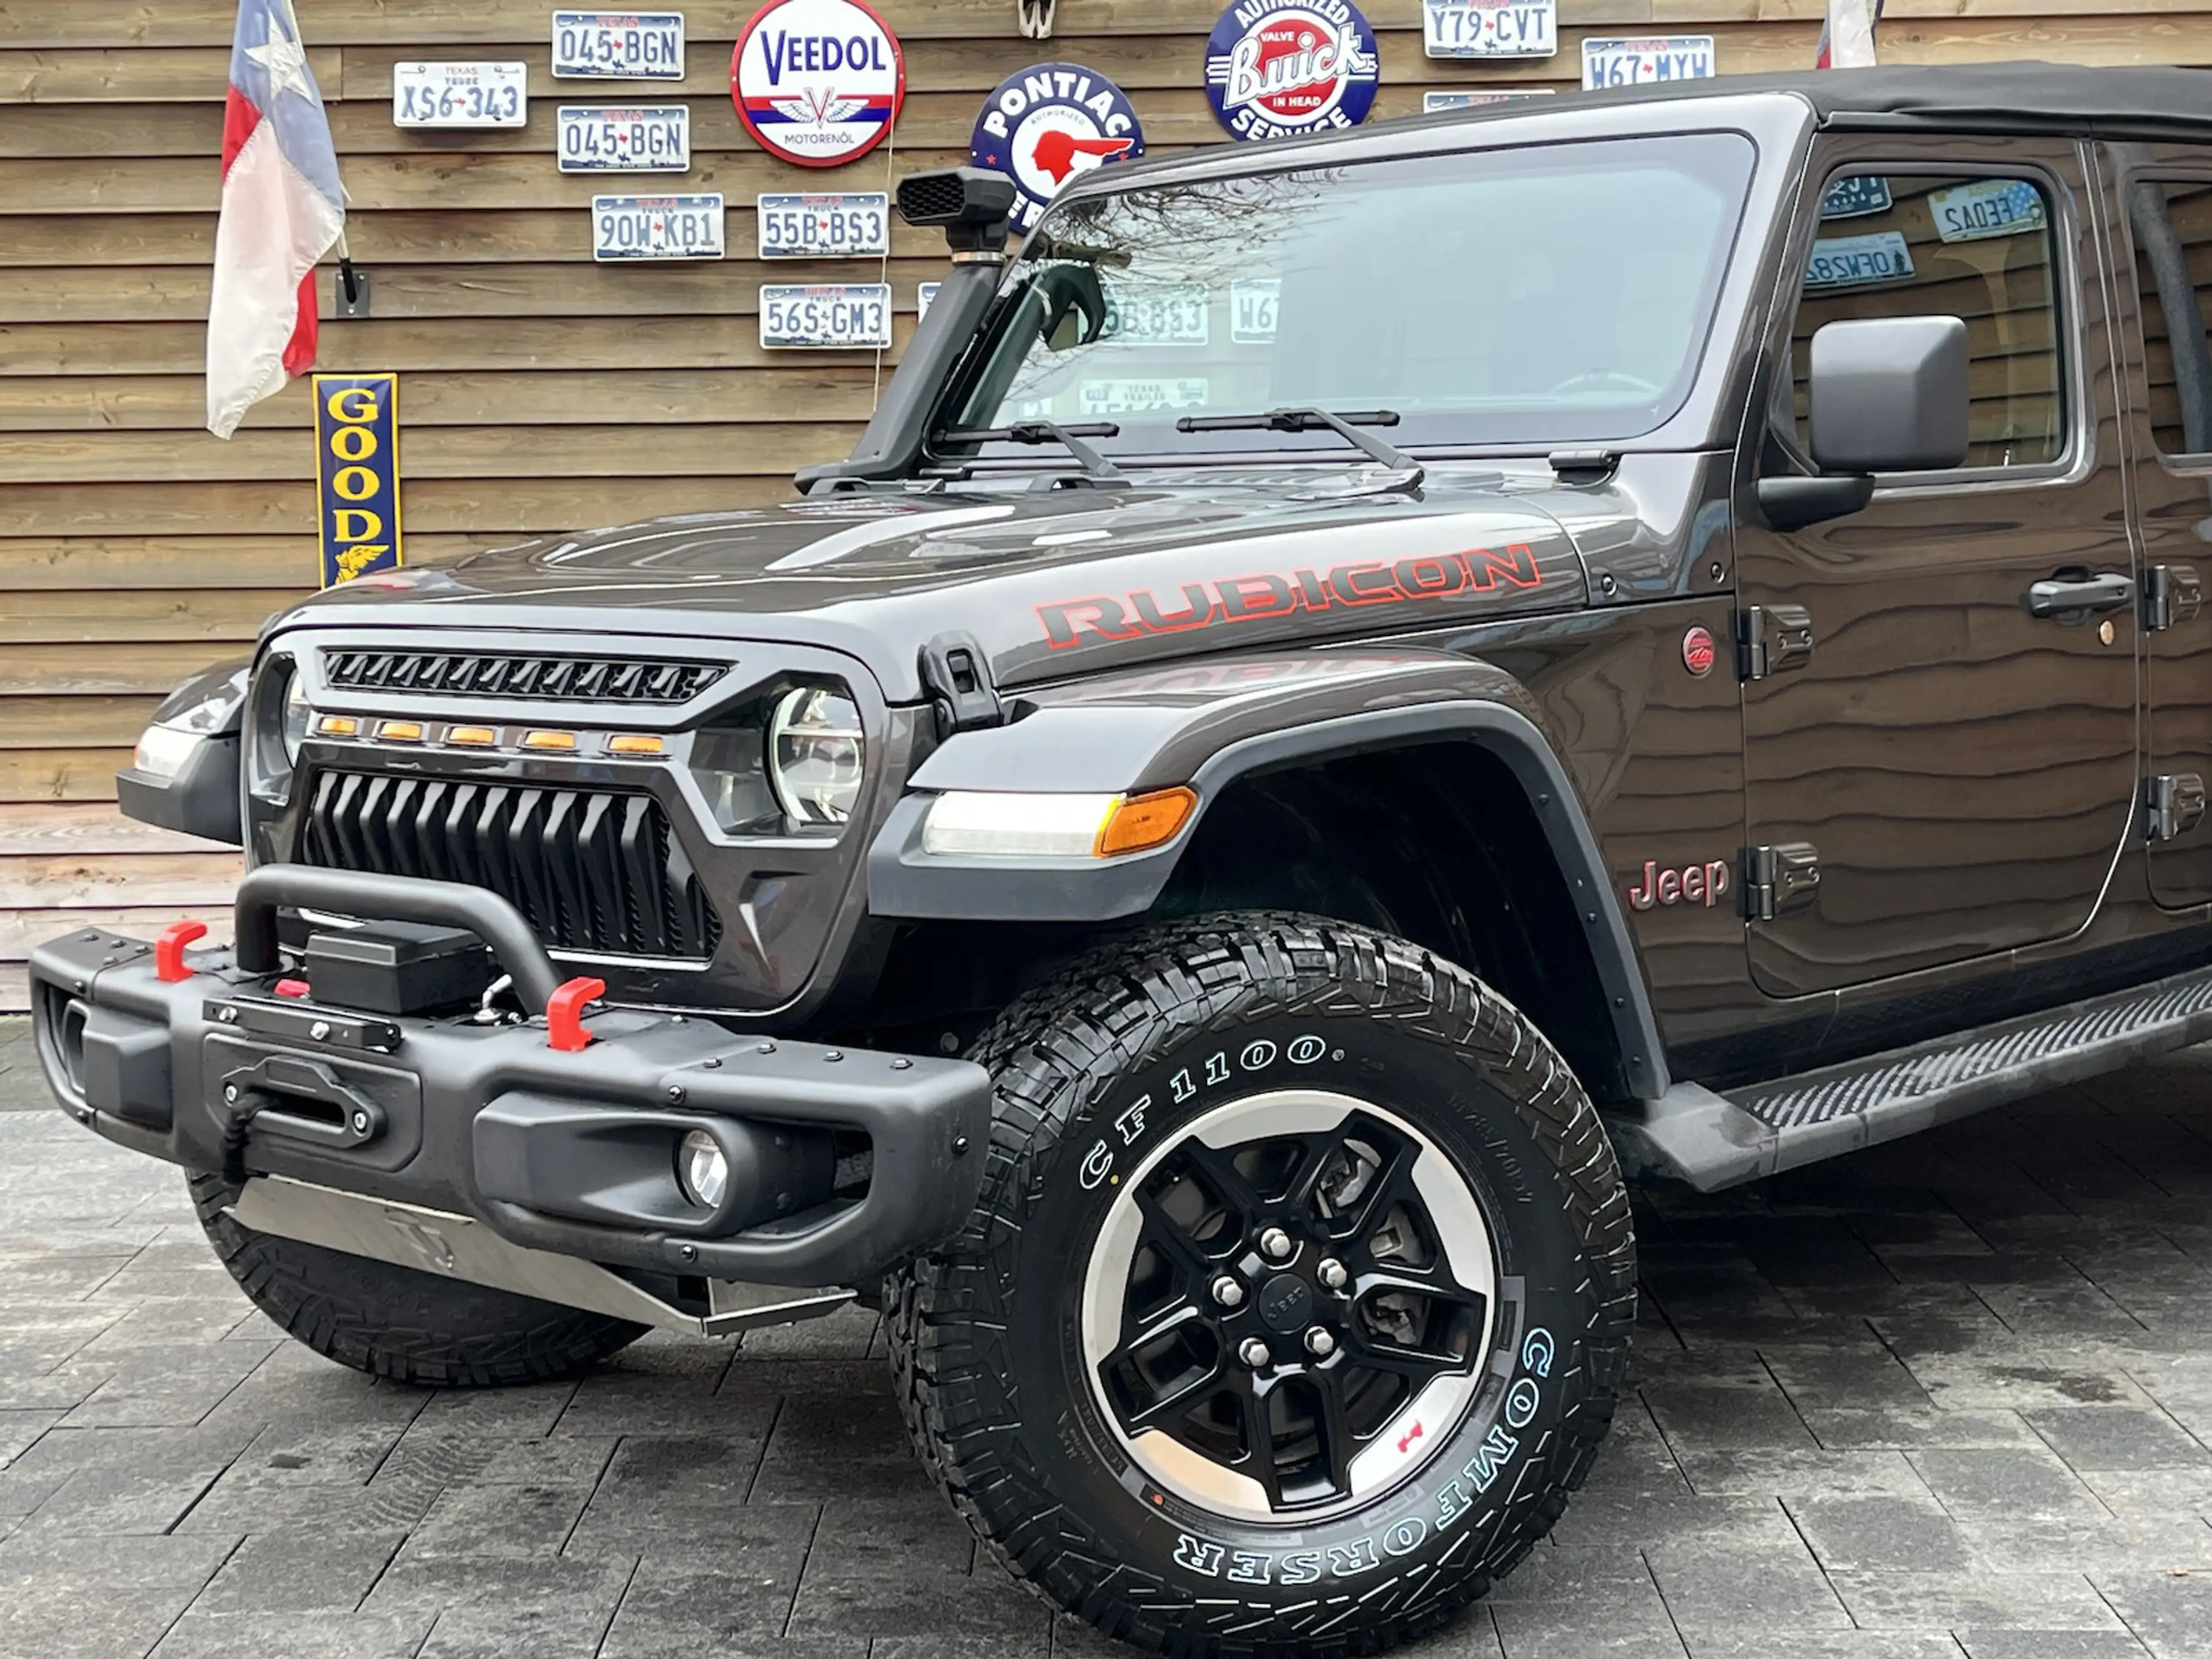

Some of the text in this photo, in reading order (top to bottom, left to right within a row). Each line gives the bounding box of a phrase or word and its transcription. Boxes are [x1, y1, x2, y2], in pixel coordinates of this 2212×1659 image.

[1260, 31, 1294, 41] VALVE
[1431, 9, 1547, 42] Y79 CVT
[561, 29, 676, 63] 045 BGN
[760, 30, 886, 86] VEEDOL
[445, 66, 478, 75] TEXAS
[1222, 21, 1371, 110] Buick
[1591, 55, 1641, 89] W67
[402, 86, 517, 118] XS6 343
[983, 71, 1132, 138] PONTIAC
[1273, 97, 1321, 107] IN HEAD
[566, 123, 680, 155] 045 BGN
[601, 214, 715, 247] 90W KB1
[766, 211, 881, 244] 55B BS3
[769, 303, 882, 334] 56S GM3
[1240, 297, 1279, 329] W6
[1036, 543, 1541, 649] RUBICON
[1629, 859, 1729, 910] Jeep
[1080, 1036, 1326, 1190] CF 1100
[1173, 1327, 1555, 1585] COMFORSER
